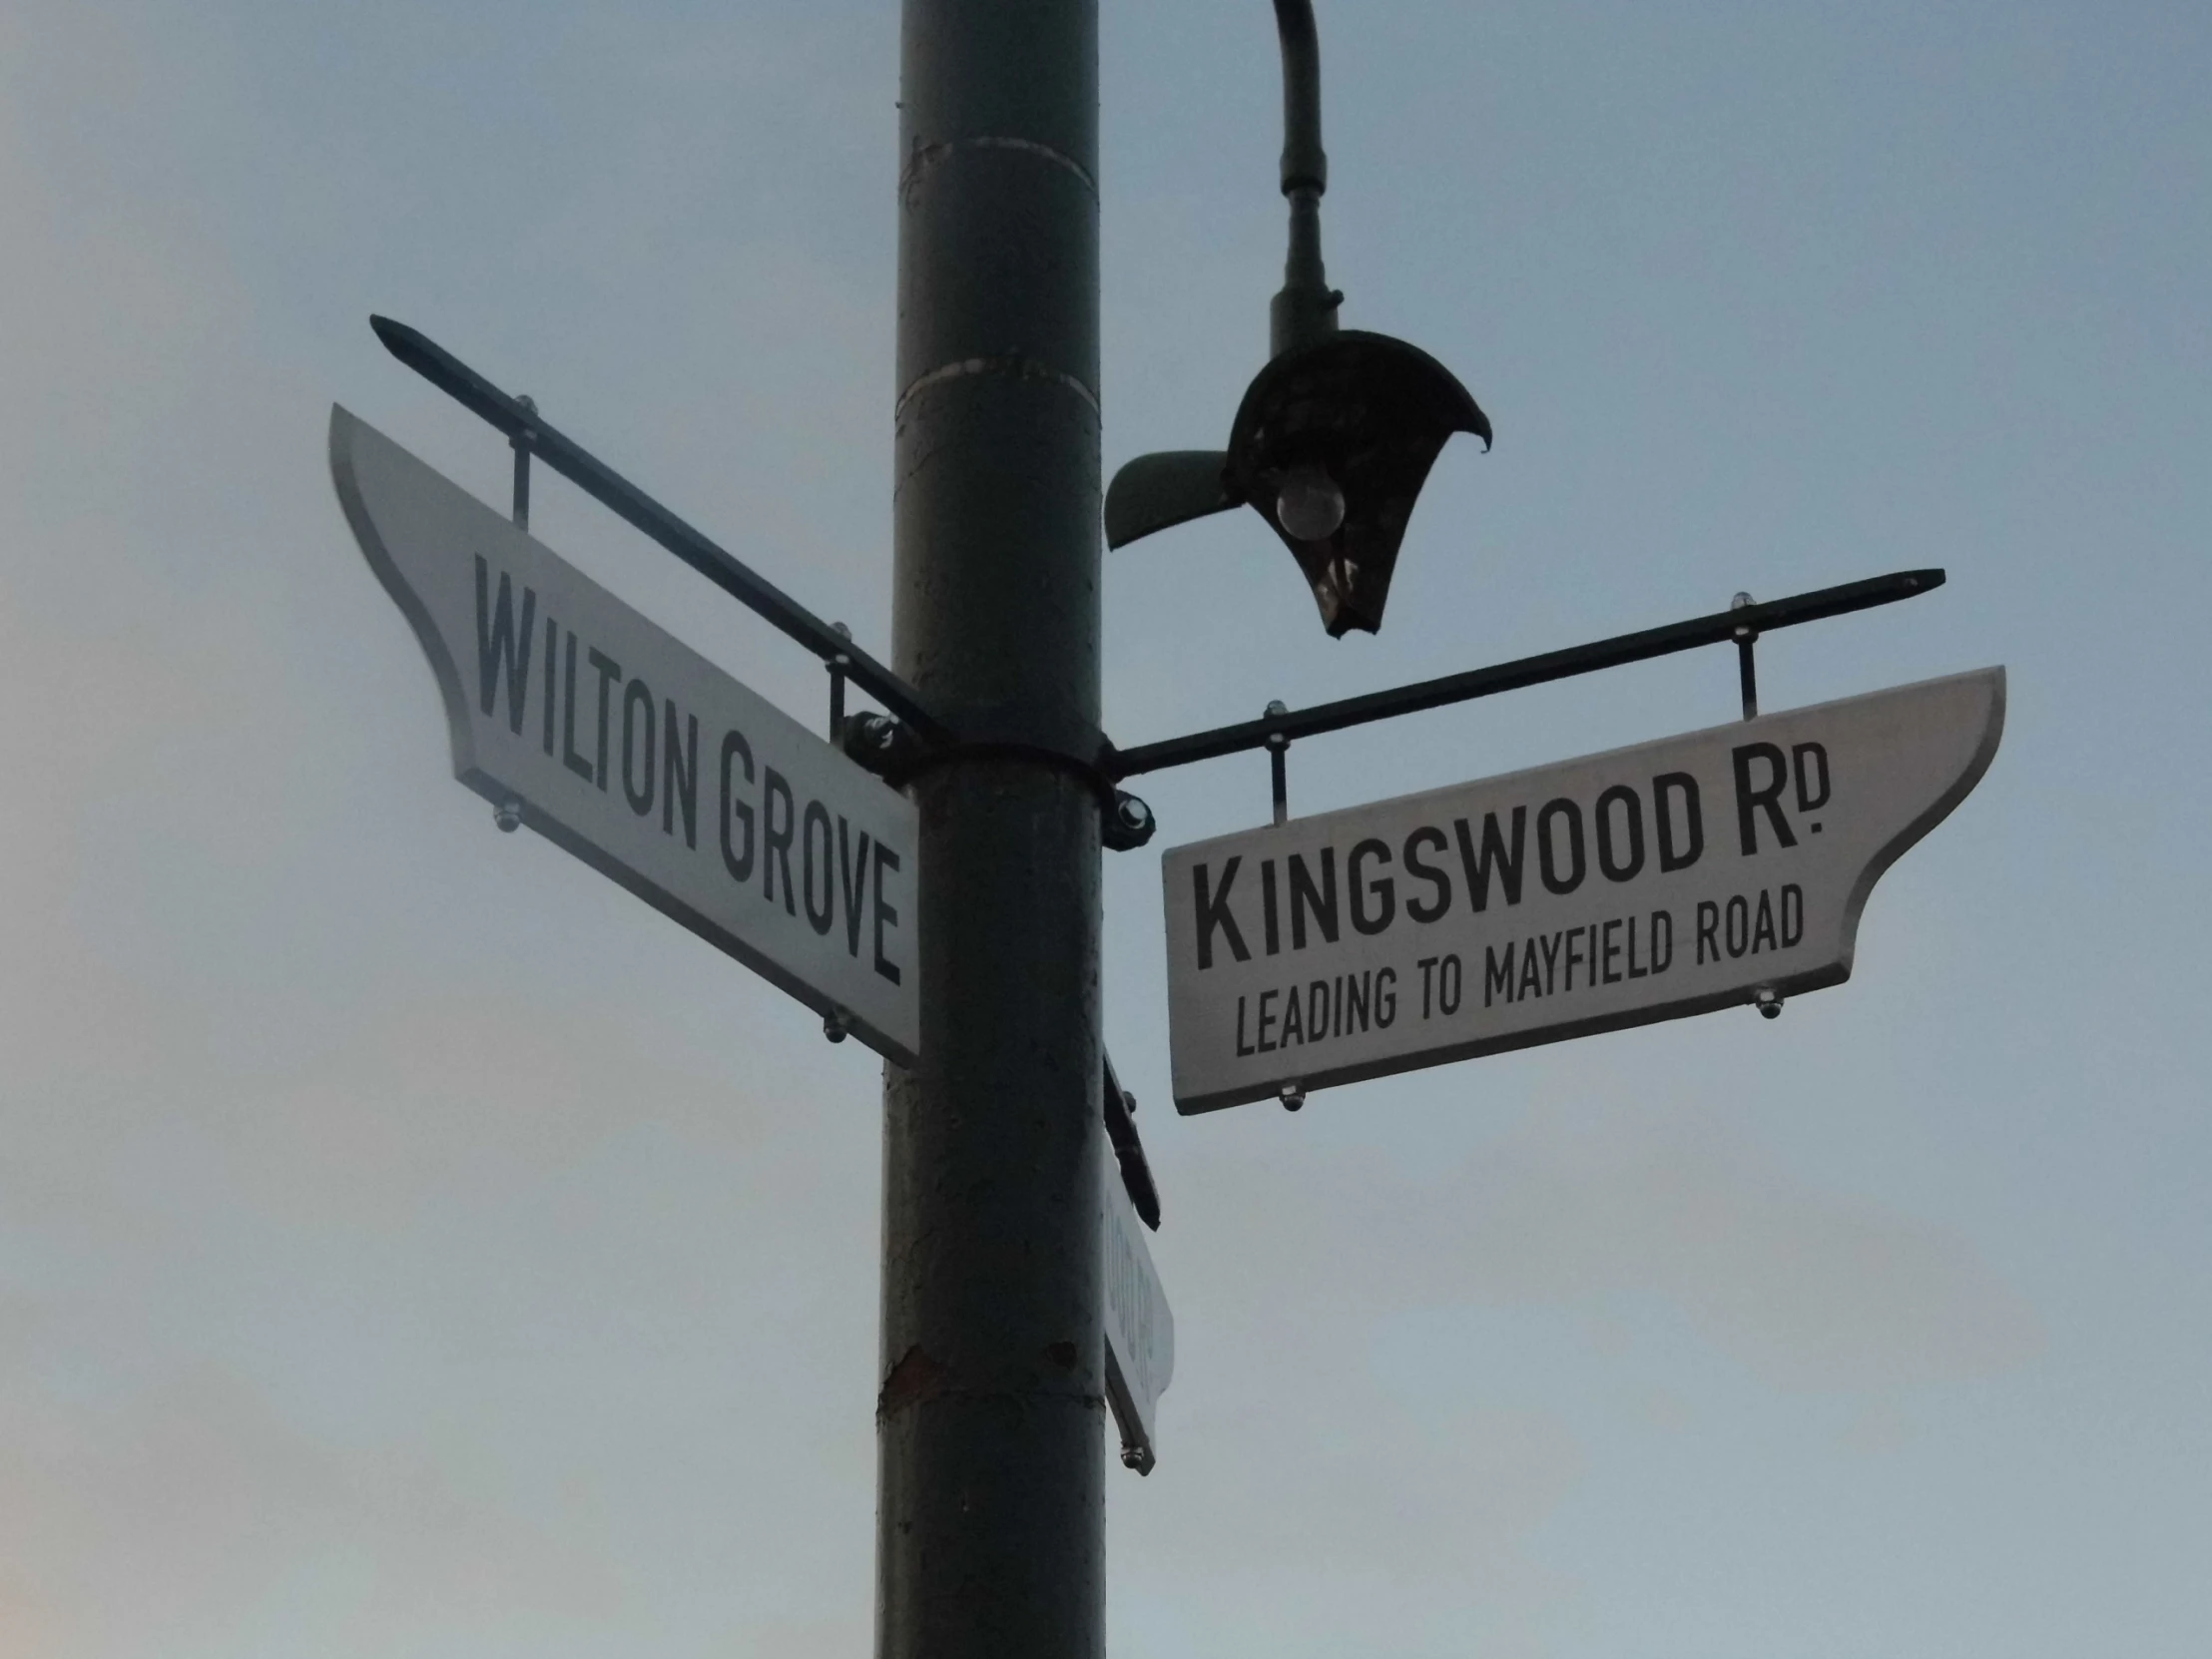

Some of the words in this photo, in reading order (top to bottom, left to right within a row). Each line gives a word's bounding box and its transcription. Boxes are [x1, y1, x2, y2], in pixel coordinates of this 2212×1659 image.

[475, 552, 698, 851] WILTON
[721, 730, 900, 986] GROVE
[1192, 772, 1704, 970] KINGSWOOD
[1237, 966, 1396, 1057] LEADING
[1418, 953, 1461, 1020] TO
[1484, 909, 1672, 1008] MAYFIELD
[1696, 883, 1804, 965] ROAD
